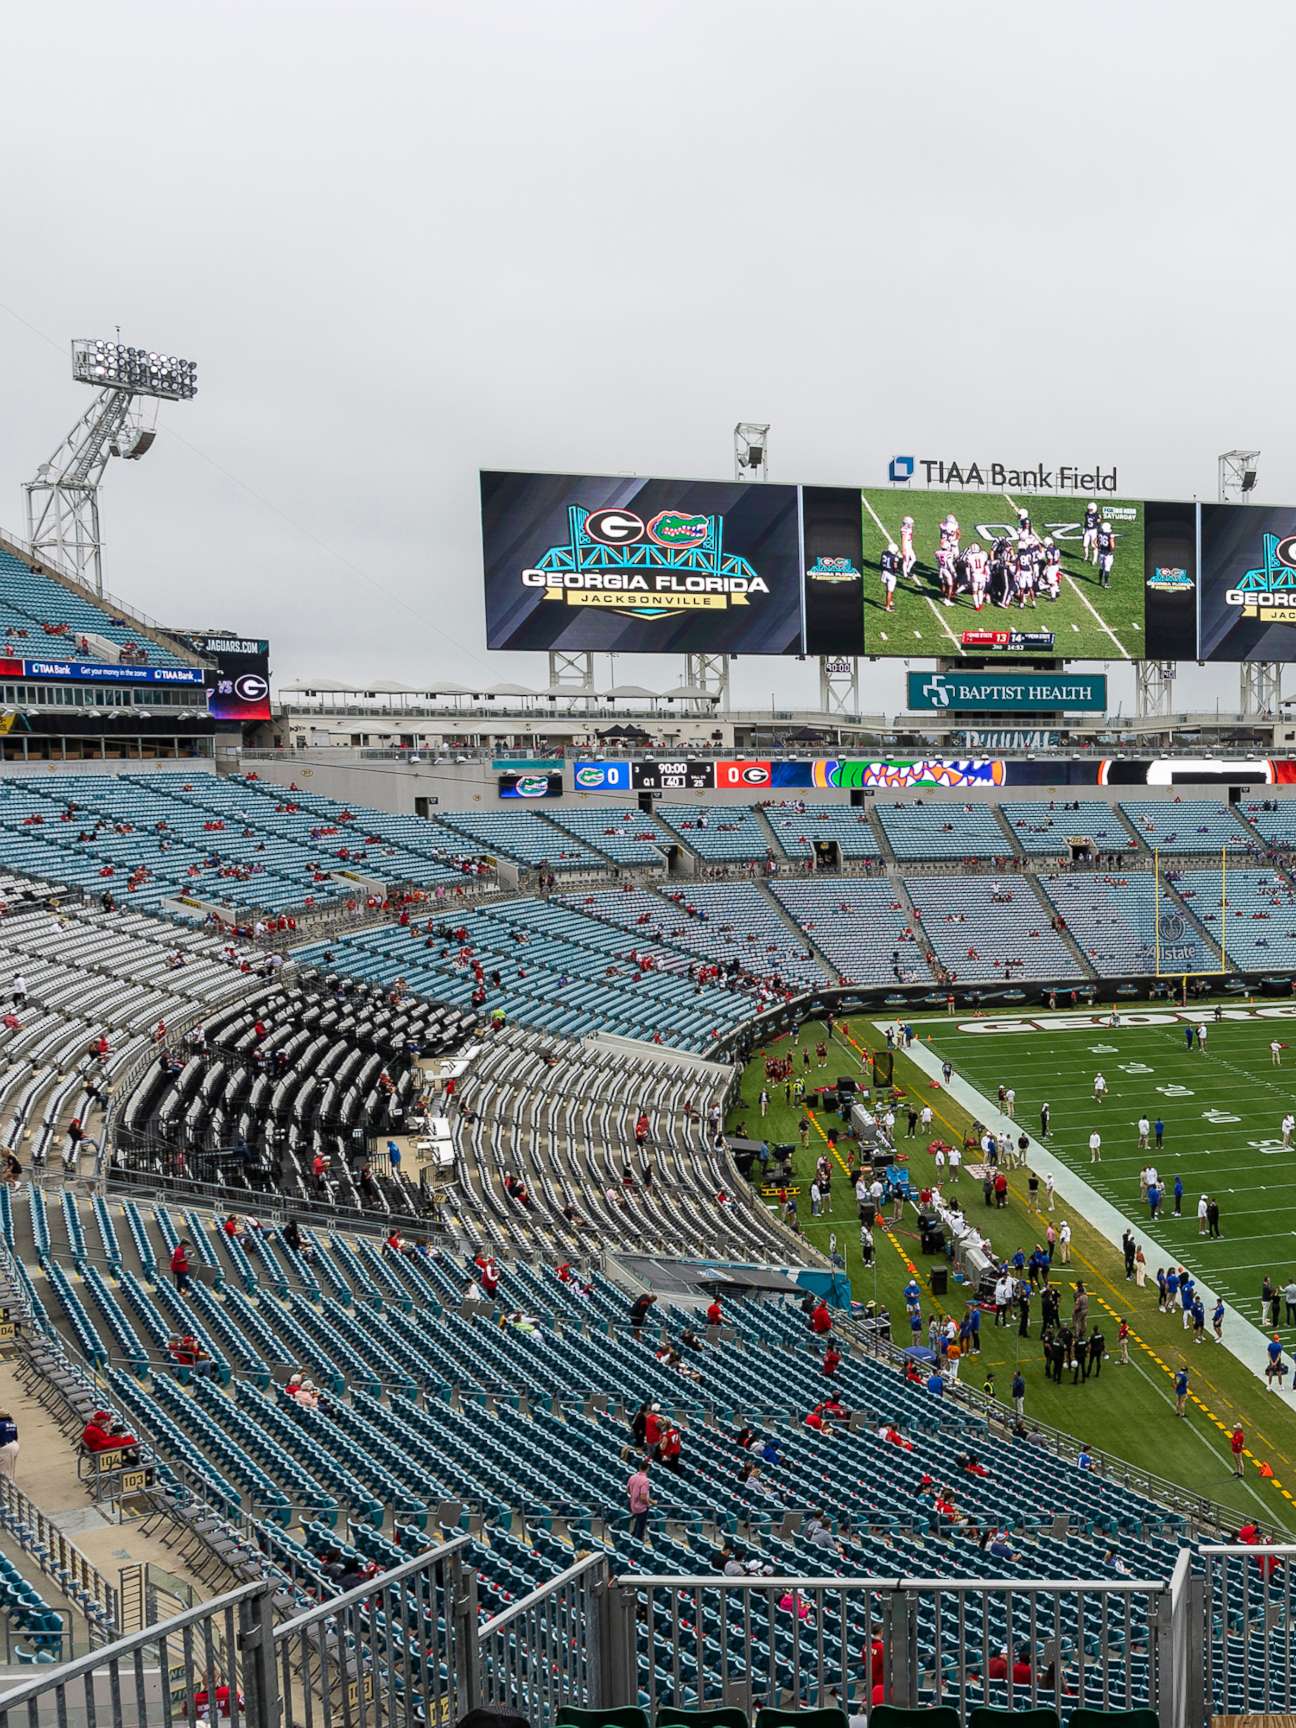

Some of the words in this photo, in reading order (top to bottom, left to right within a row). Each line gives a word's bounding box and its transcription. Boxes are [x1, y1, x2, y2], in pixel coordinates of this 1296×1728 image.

[920, 461, 984, 485] TIAA
[991, 463, 1052, 489] Bank
[1060, 466, 1117, 492] Field
[522, 568, 648, 590] GEORGIA
[656, 575, 769, 593] FLORIDA
[581, 594, 711, 606] JACKSONVILLE
[996, 634, 1007, 642] 13
[1012, 634, 1021, 642] 14
[206, 639, 258, 654] JAGUARS.COM
[39, 665, 55, 673] TIAA
[55, 665, 71, 675] Bank
[80, 666, 90, 674] Get
[91, 669, 102, 677] your
[103, 669, 119, 677] money
[125, 668, 134, 676] the
[163, 670, 177, 679] TIAA
[178, 671, 193, 680] Bank
[959, 686, 1024, 700] BAPTIST
[1030, 686, 1091, 700] HEALTH
[658, 763, 687, 774] 90:00
[608, 767, 619, 784] 0
[643, 777, 654, 786] Q1
[666, 776, 679, 786] 40
[728, 767, 739, 783] 0
[693, 779, 704, 787] 25
[1146, 943, 1196, 960] Alstate
[124, 1474, 144, 1488] 103
